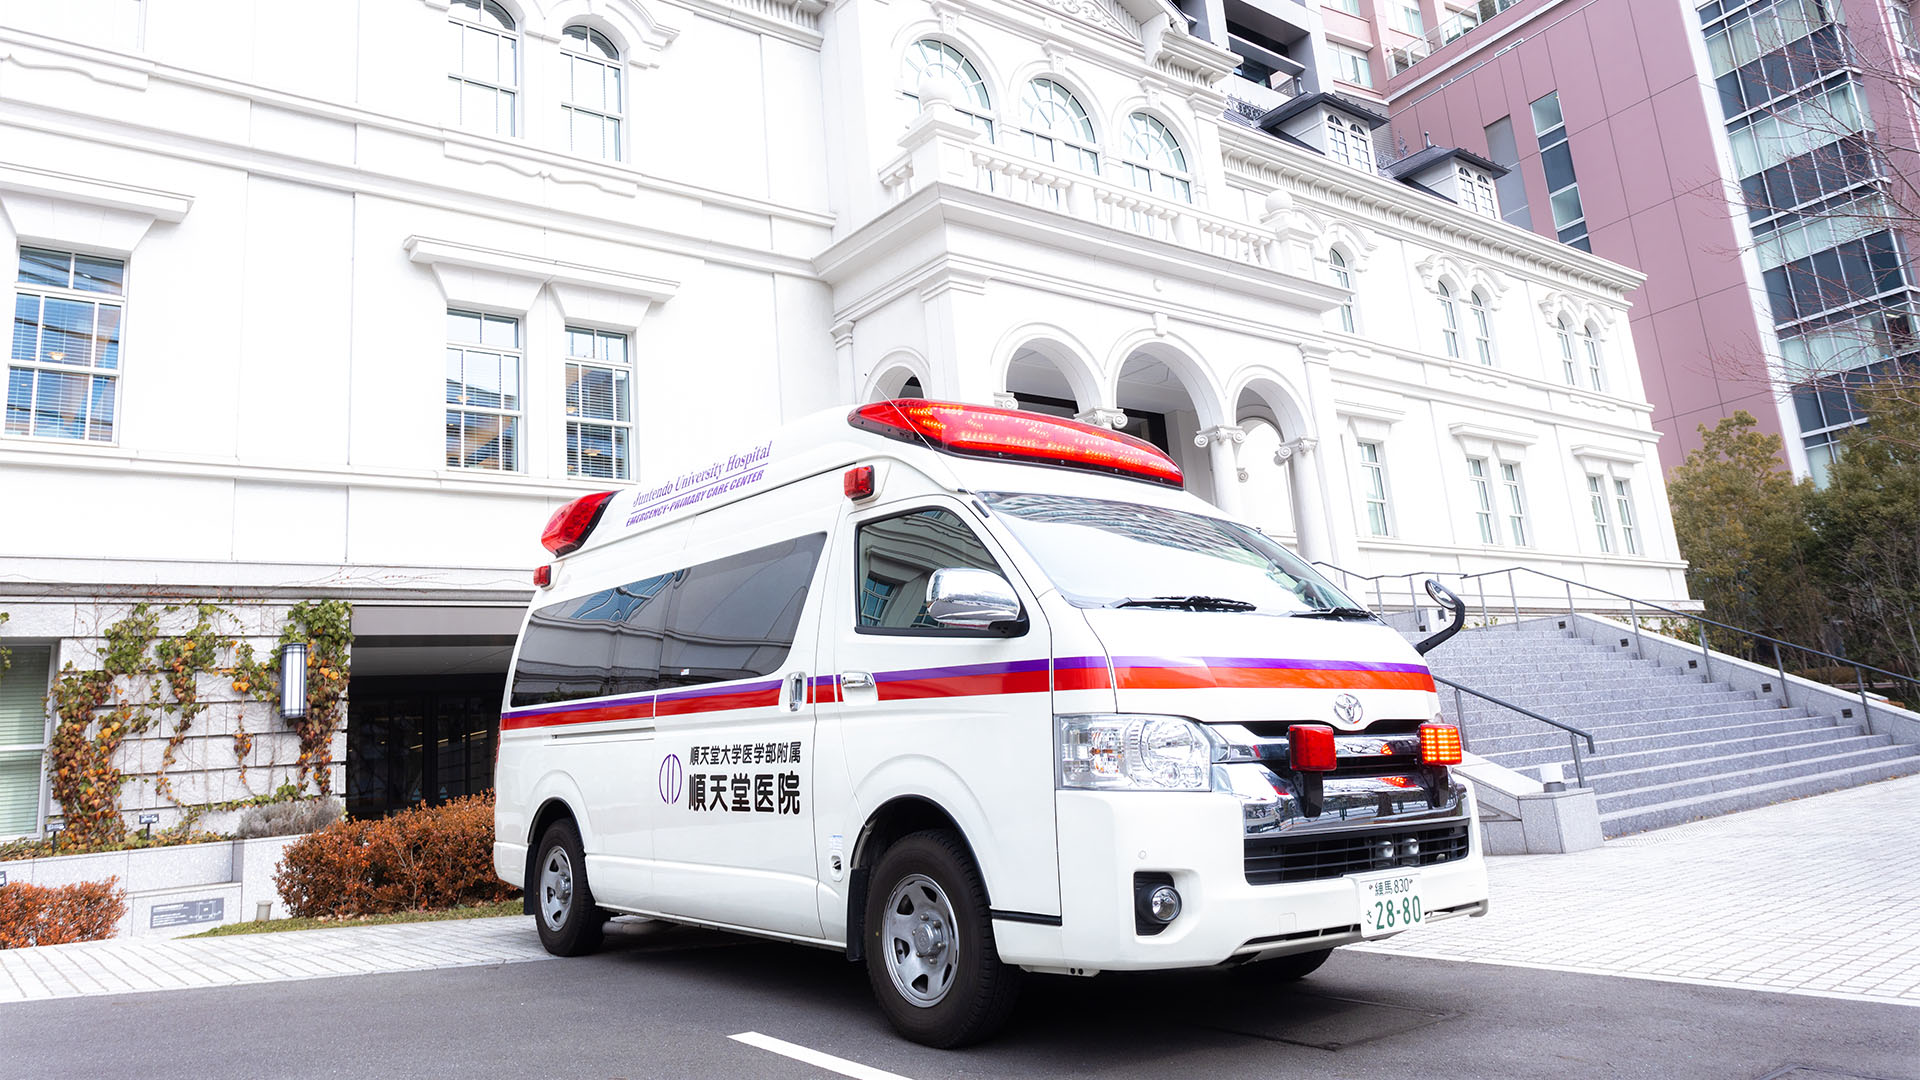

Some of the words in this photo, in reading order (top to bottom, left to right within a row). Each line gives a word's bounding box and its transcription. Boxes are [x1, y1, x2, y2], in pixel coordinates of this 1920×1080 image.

[633, 480, 673, 508] Juntendo
[675, 462, 724, 492] University
[725, 440, 773, 473] Hospital
[706, 481, 730, 501] CARE
[729, 469, 765, 491] CENTER
[689, 741, 801, 765] 順天堂大学医学部附属
[688, 770, 801, 815] 順天堂医院
[1375, 895, 1421, 930] 28-80
